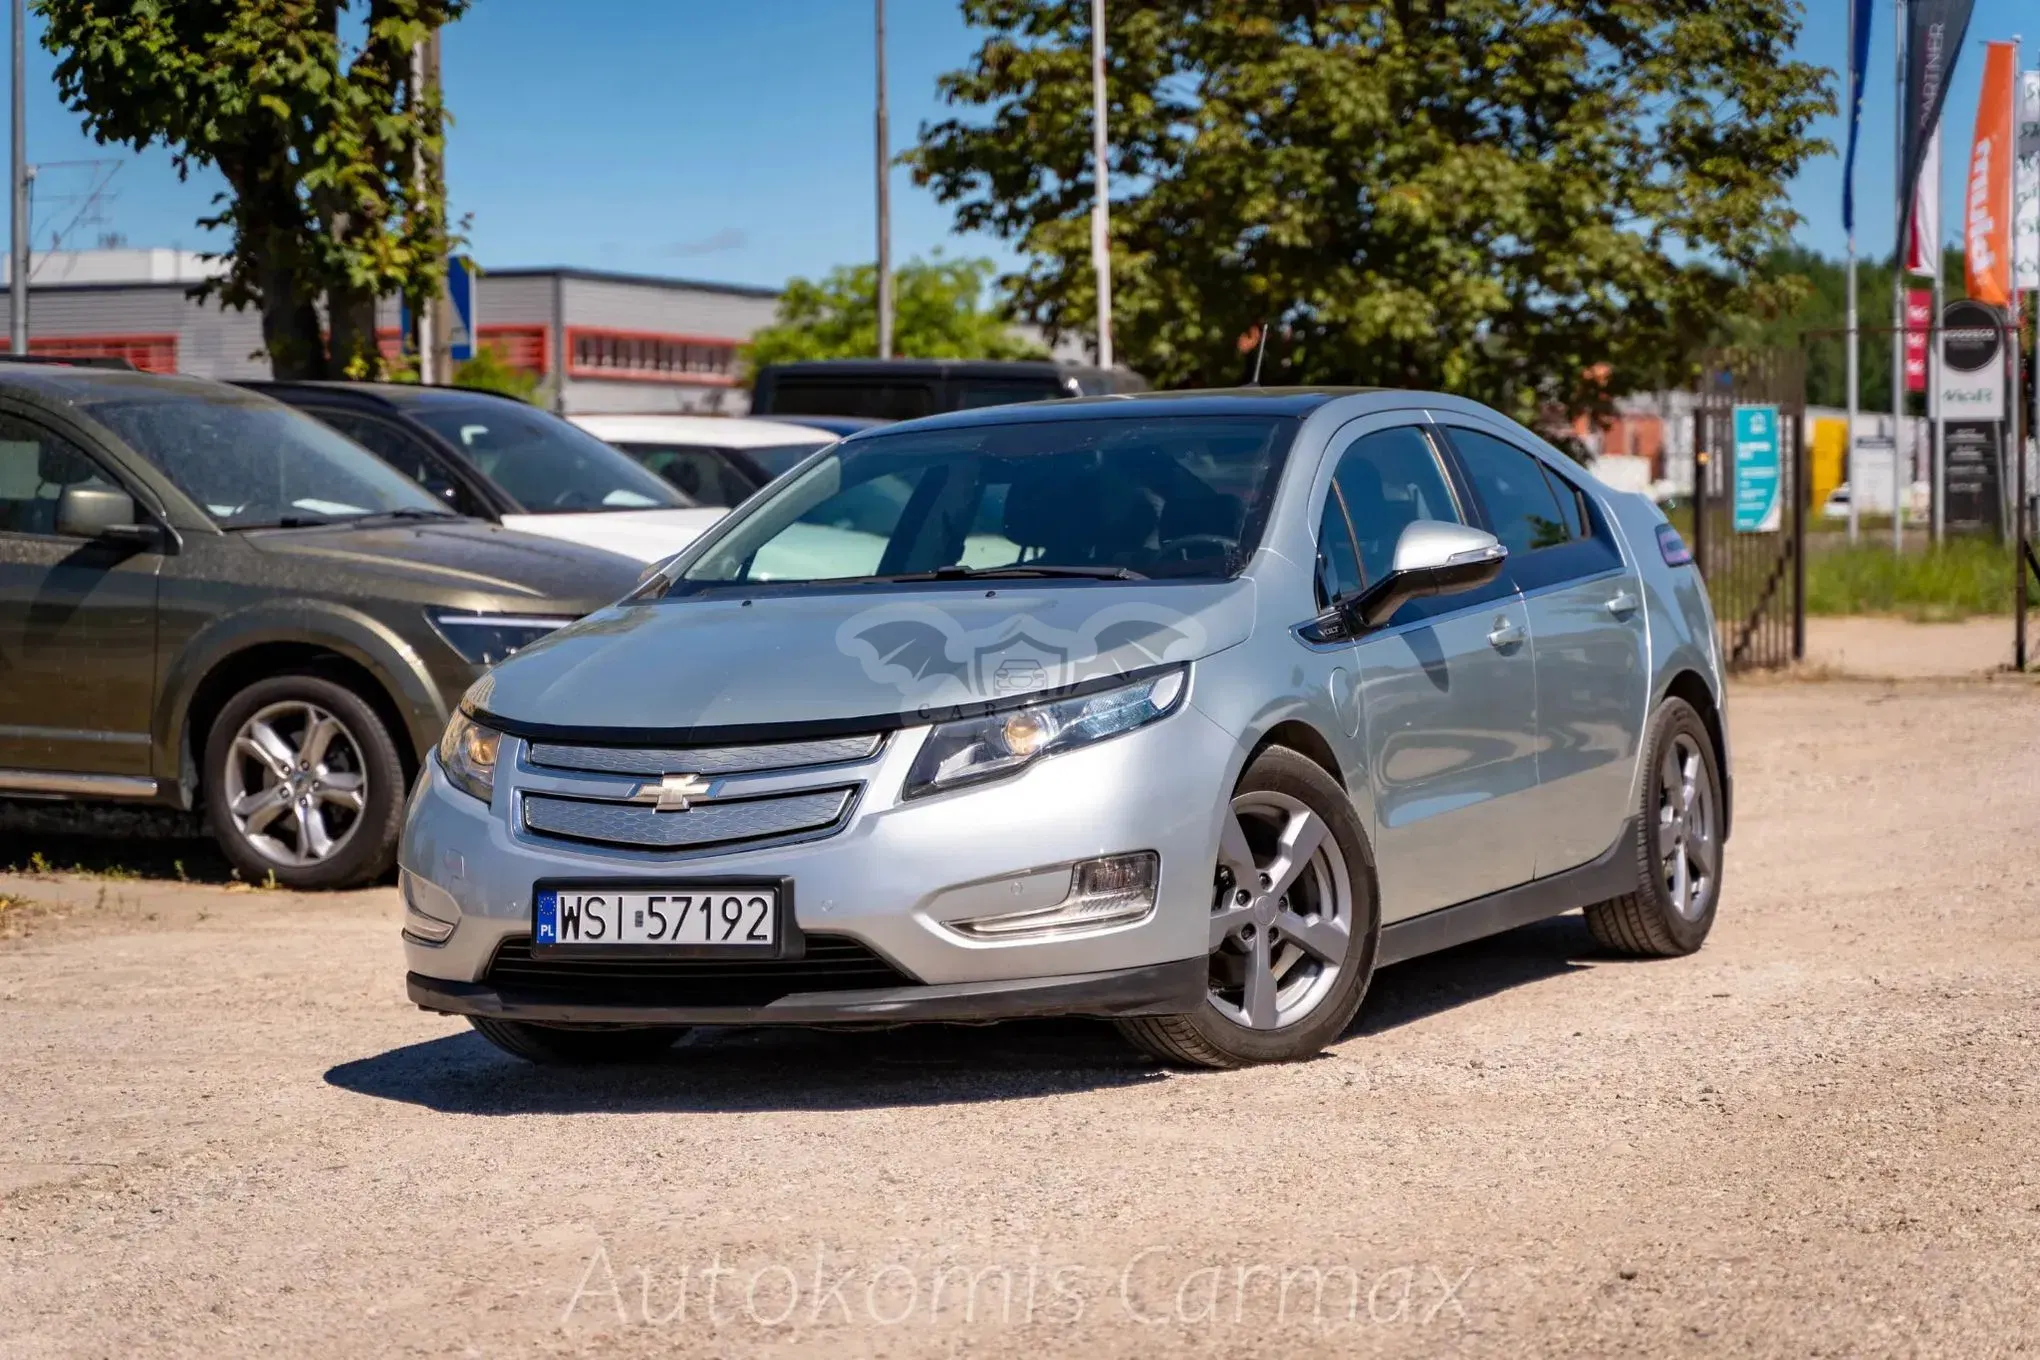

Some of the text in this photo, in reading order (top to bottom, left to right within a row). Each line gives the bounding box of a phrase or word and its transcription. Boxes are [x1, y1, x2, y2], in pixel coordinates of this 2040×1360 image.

[540, 924, 555, 937] PL
[560, 896, 768, 941] WSI 57192
